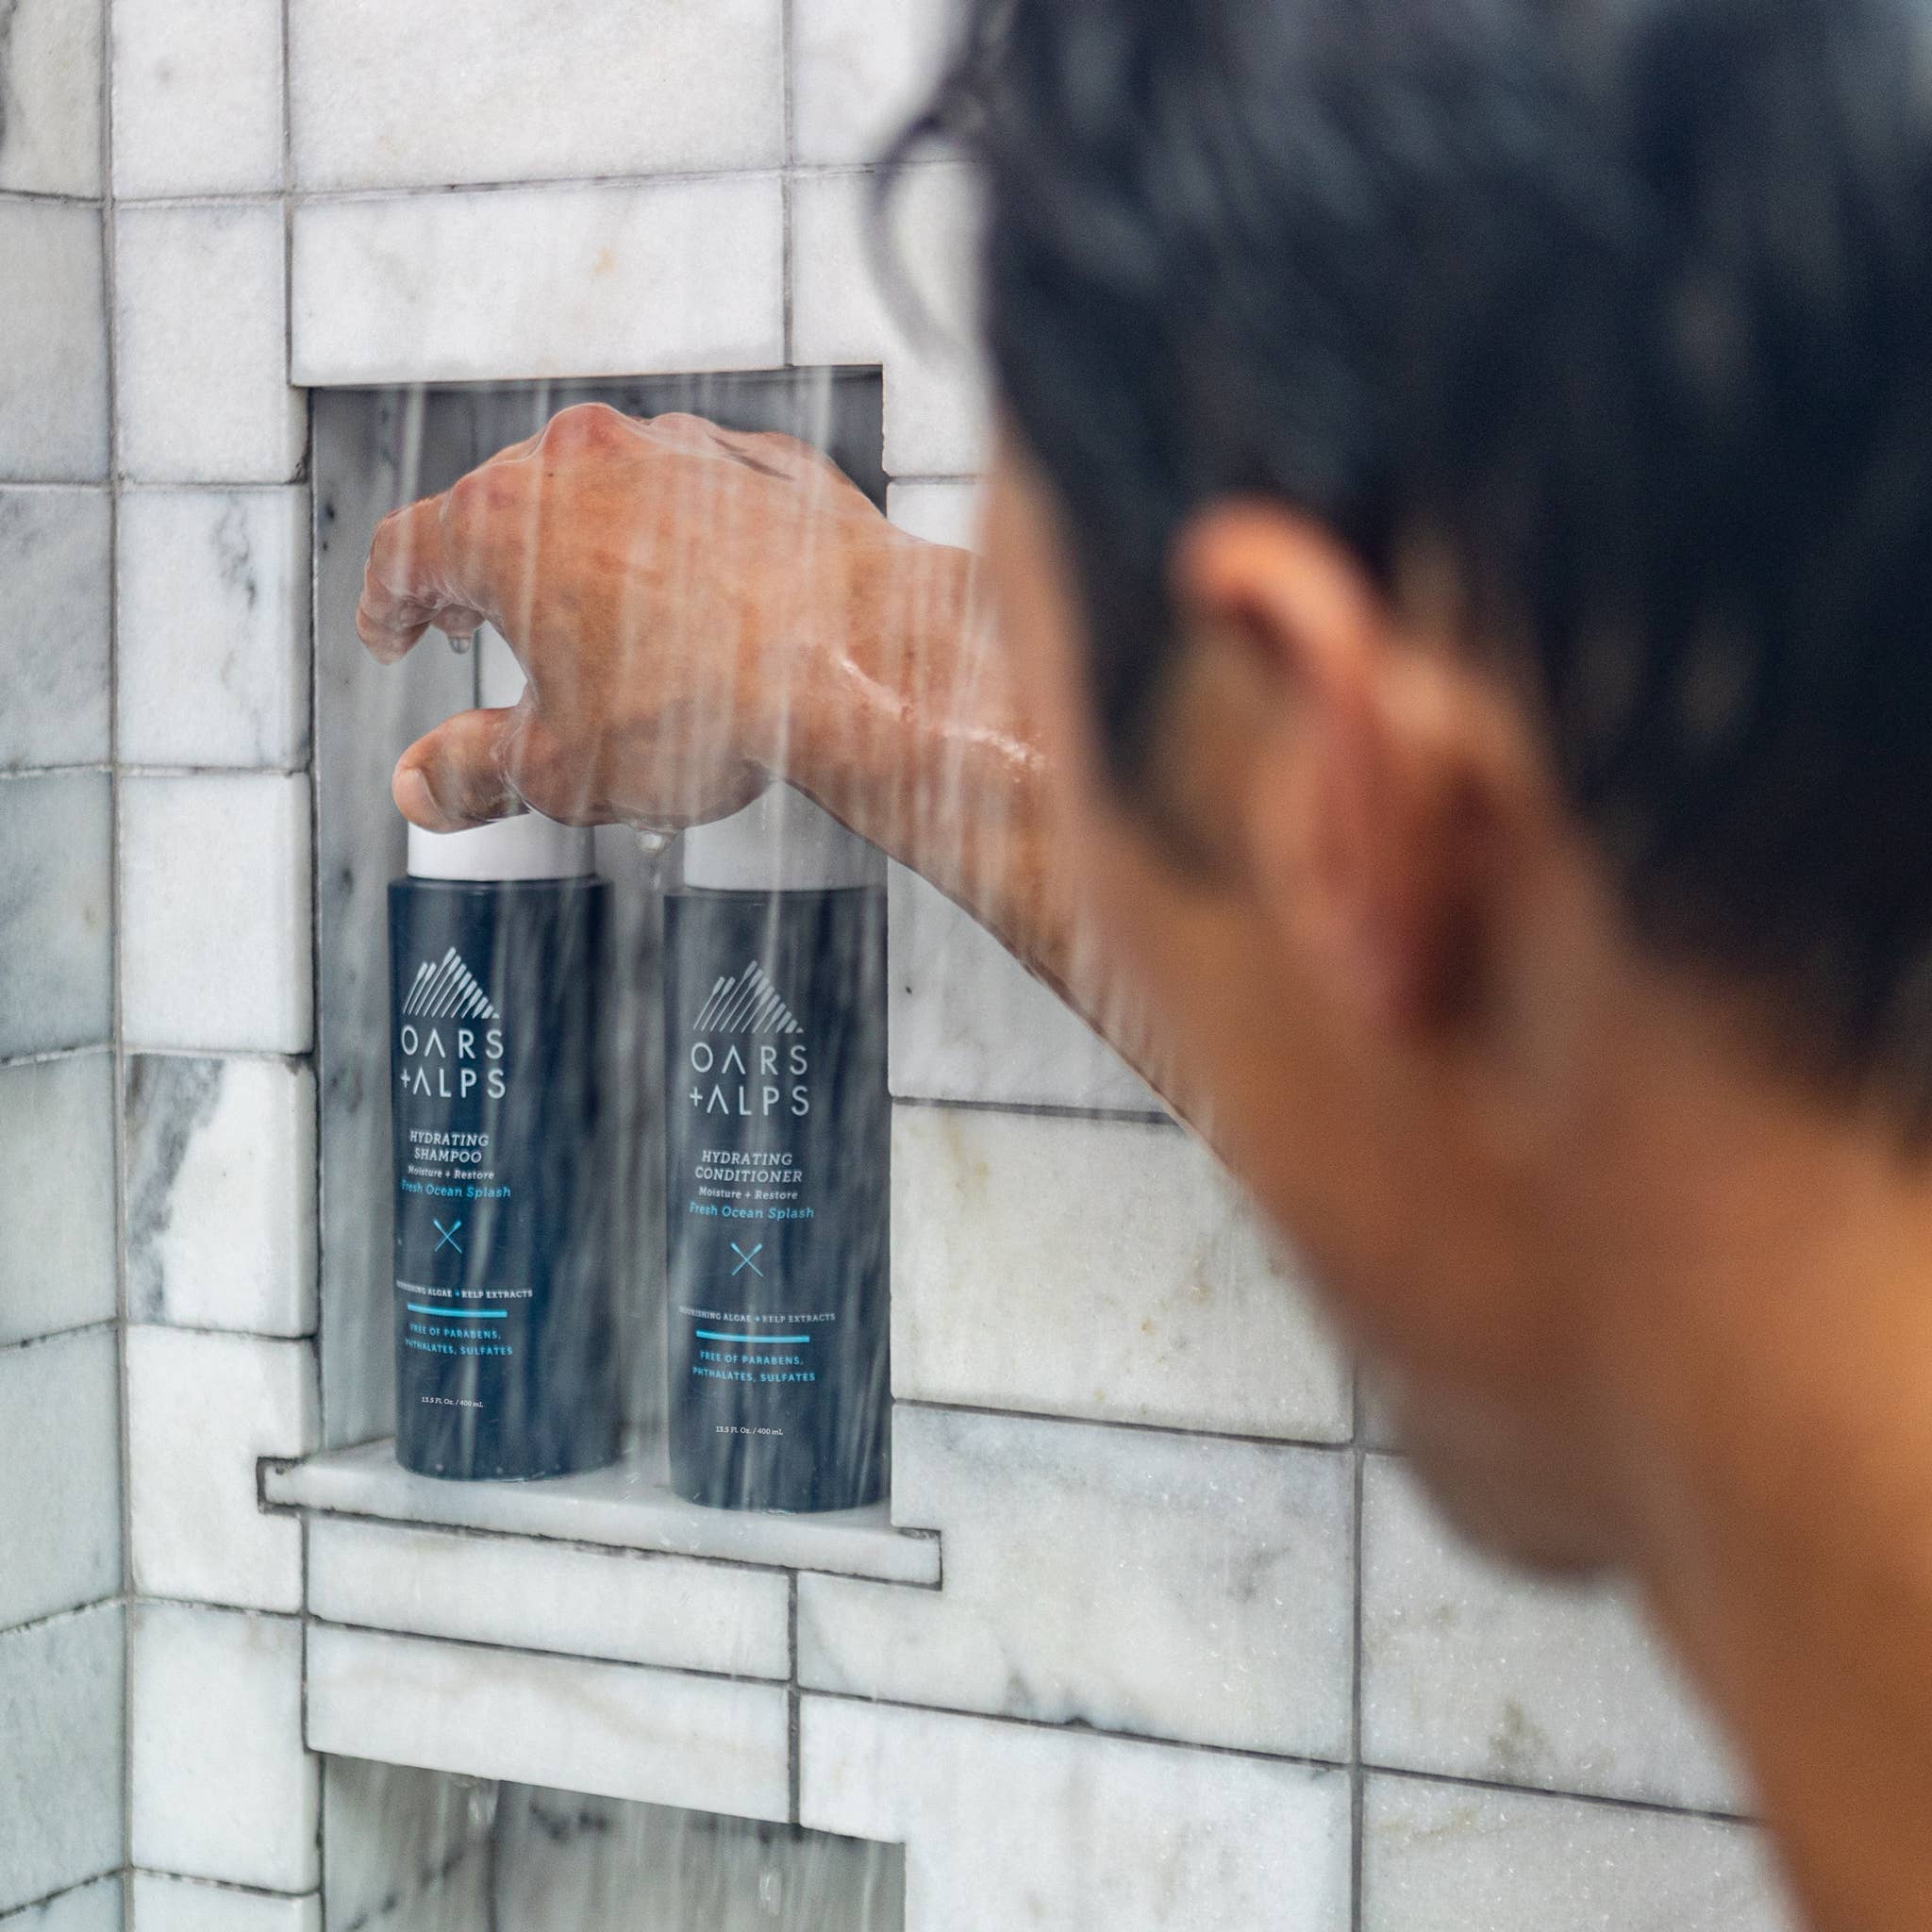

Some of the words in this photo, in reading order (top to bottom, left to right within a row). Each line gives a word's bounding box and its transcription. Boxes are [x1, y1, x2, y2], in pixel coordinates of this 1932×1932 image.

[401, 1024, 504, 1059] OARS
[691, 1042, 808, 1075] OARS
[409, 1130, 490, 1147] HYDRATING
[414, 1147, 482, 1163] SHAMPOO
[702, 1150, 792, 1166] HYDRATING
[408, 1165, 442, 1177] Moisture
[454, 1170, 494, 1179] Restore
[694, 1167, 802, 1182] CONDITIONER
[425, 1184, 462, 1197] Ocean
[466, 1186, 511, 1200] Splash
[699, 1187, 741, 1199] Moisture
[755, 1191, 798, 1200] Restore
[690, 1201, 718, 1216] Fresh
[722, 1206, 763, 1219] Ocean
[768, 1208, 814, 1221] Splash
[427, 1289, 452, 1297] ALGAE
[486, 1290, 533, 1299] EXTRACTS
[724, 1312, 751, 1322] ALGAE
[789, 1313, 836, 1323] EXTRACTS
[410, 1324, 426, 1335] FREE
[429, 1327, 440, 1336] OF
[460, 1346, 513, 1356] SULFATES
[700, 1351, 721, 1362] FREE
[724, 1355, 738, 1363] OF
[760, 1374, 815, 1382] SULFATES
